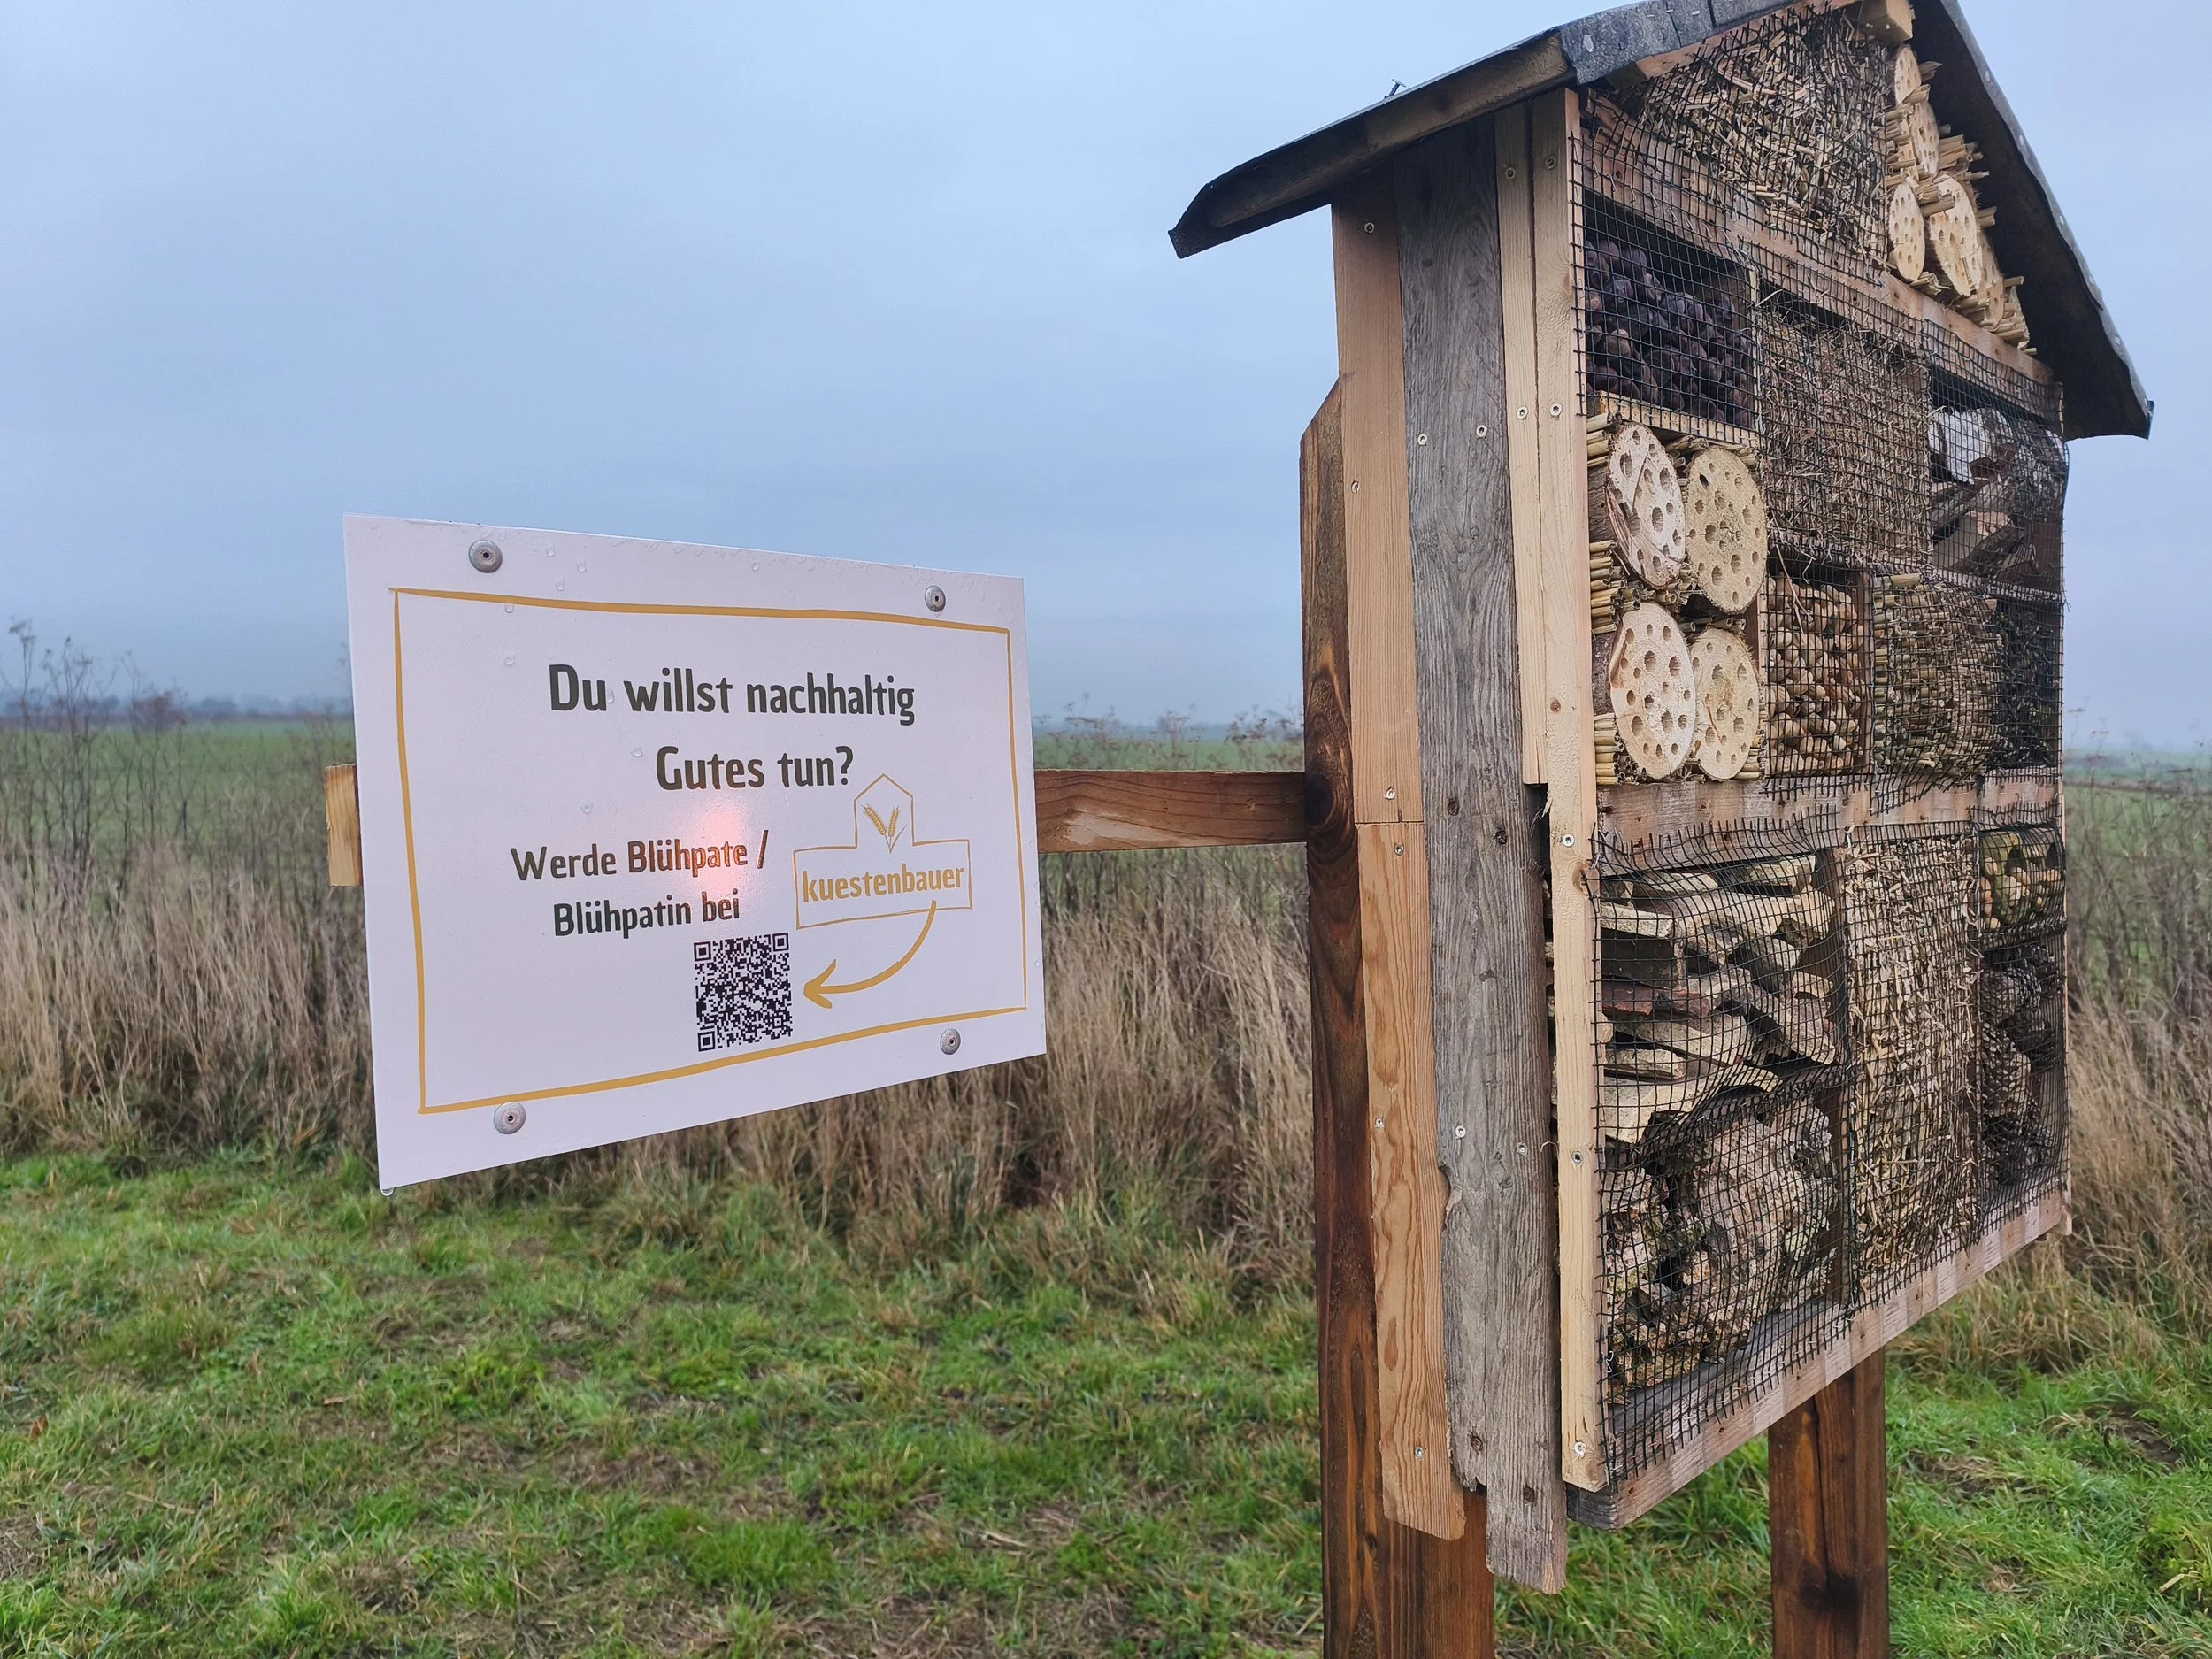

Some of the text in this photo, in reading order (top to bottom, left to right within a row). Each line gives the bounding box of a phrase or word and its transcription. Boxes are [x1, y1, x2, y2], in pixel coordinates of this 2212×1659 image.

[549, 664, 915, 725] Du willst nachhaltig
[657, 746, 854, 790] Gutes tun?
[511, 830, 768, 881] Werde Blühpate /
[801, 864, 965, 903] kuestenbauer
[554, 889, 740, 939] Blühpatin bei
